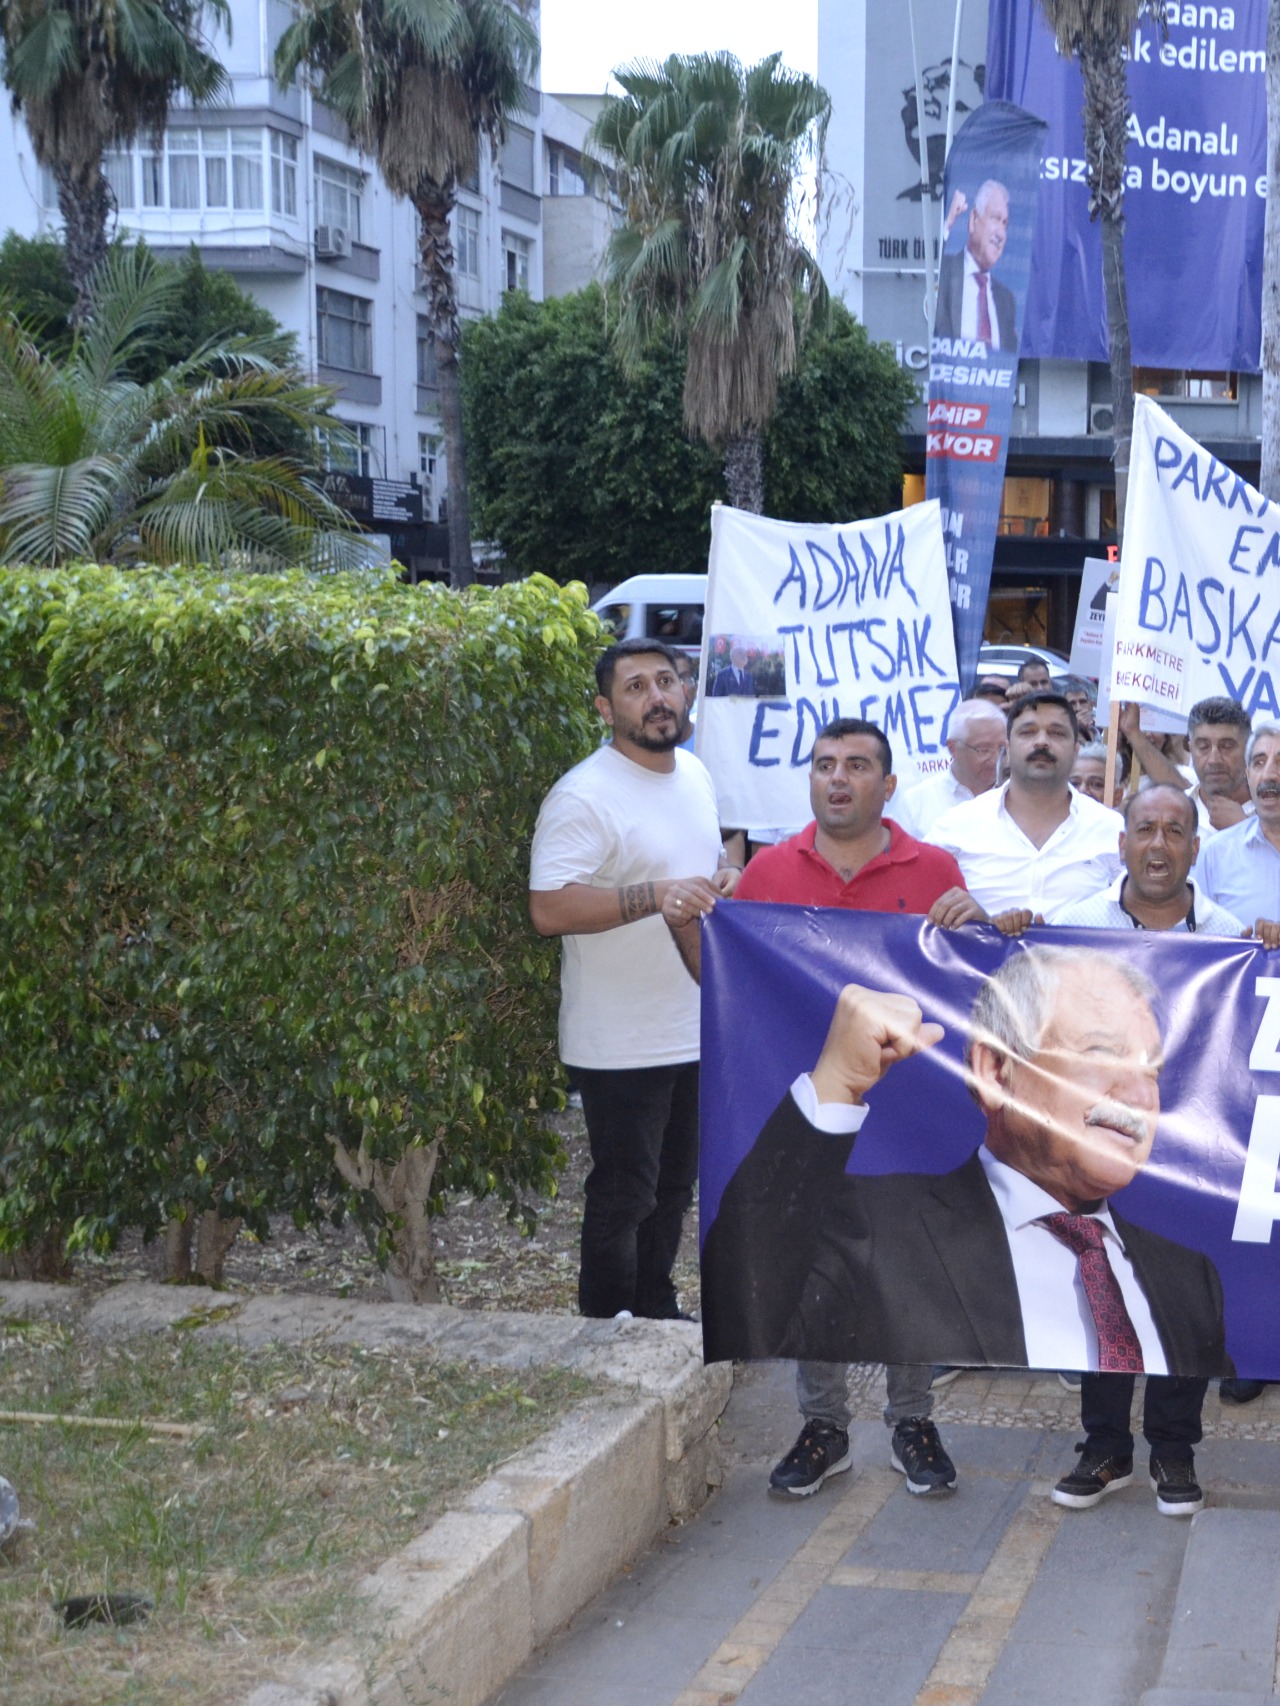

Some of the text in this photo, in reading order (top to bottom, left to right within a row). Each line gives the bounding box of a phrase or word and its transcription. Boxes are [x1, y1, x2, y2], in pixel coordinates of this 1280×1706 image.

[1138, 1, 1235, 30] dana
[1160, 36, 1267, 72] edilem
[1126, 112, 1238, 156] Adanalı
[1151, 157, 1247, 204] boyun
[878, 235, 908, 260] TÜRK
[930, 337, 988, 360] DANA
[928, 403, 982, 426] AHİP
[773, 522, 919, 612] ADANA
[777, 614, 948, 688] TUTSAK
